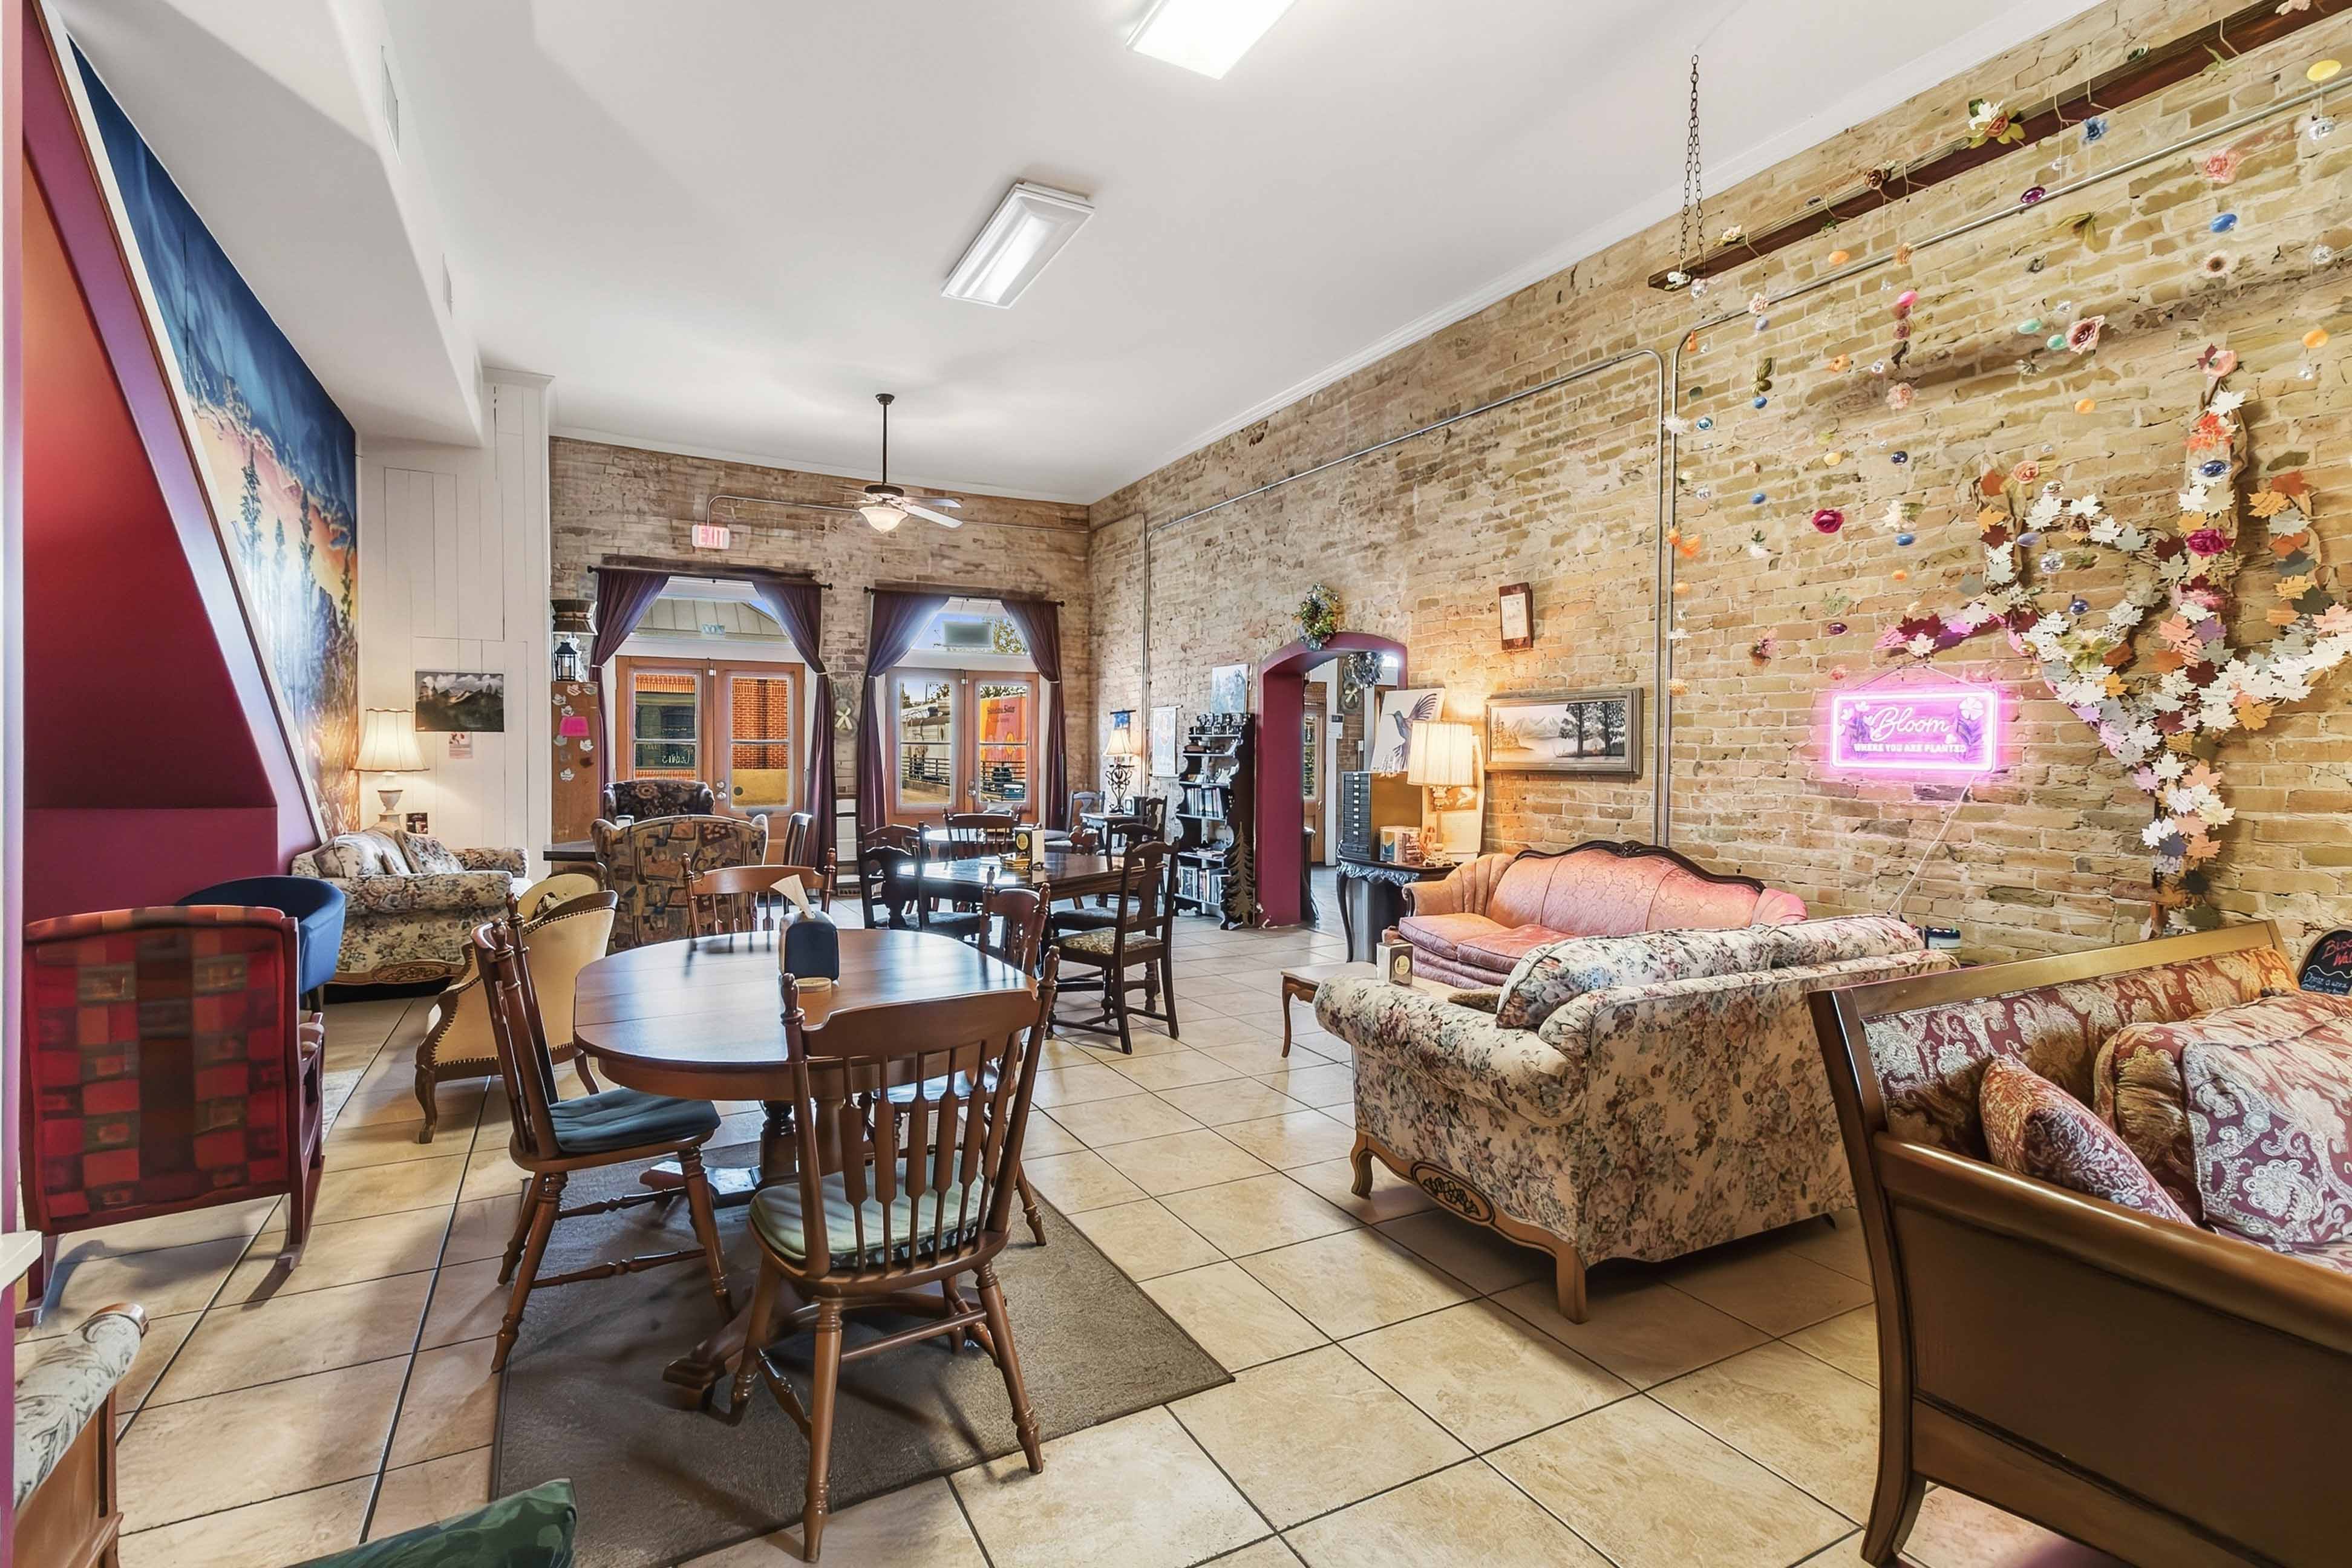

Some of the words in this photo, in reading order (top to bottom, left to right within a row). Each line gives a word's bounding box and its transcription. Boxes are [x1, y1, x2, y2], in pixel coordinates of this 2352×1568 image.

[697, 526, 725, 547] EXIT
[1870, 707, 1950, 742] Bloom
[1854, 743, 1884, 753] WHERE
[1885, 743, 1903, 753] YOU
[1904, 743, 1922, 753] ARE
[1924, 744, 1967, 753] PLANTED
